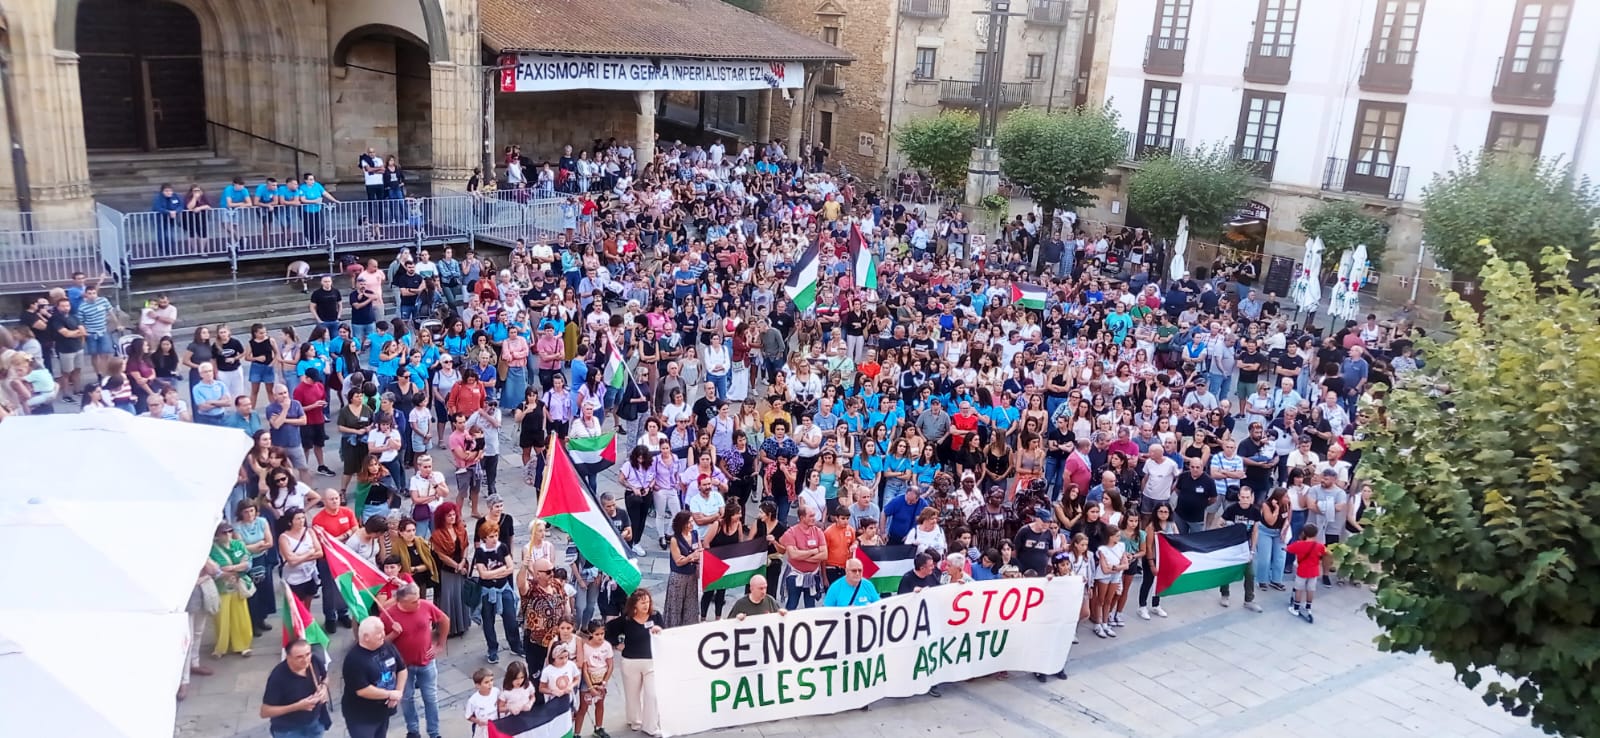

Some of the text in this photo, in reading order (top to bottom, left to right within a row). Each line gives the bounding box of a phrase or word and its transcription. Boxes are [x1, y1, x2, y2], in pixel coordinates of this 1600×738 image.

[517, 62, 599, 80] FAXISMOARI
[604, 63, 627, 80] ETA
[630, 64, 669, 81] GERRA
[672, 65, 747, 81] INPERIALISTARI
[947, 587, 1044, 626] STOP
[913, 629, 1010, 680] ASKATU
